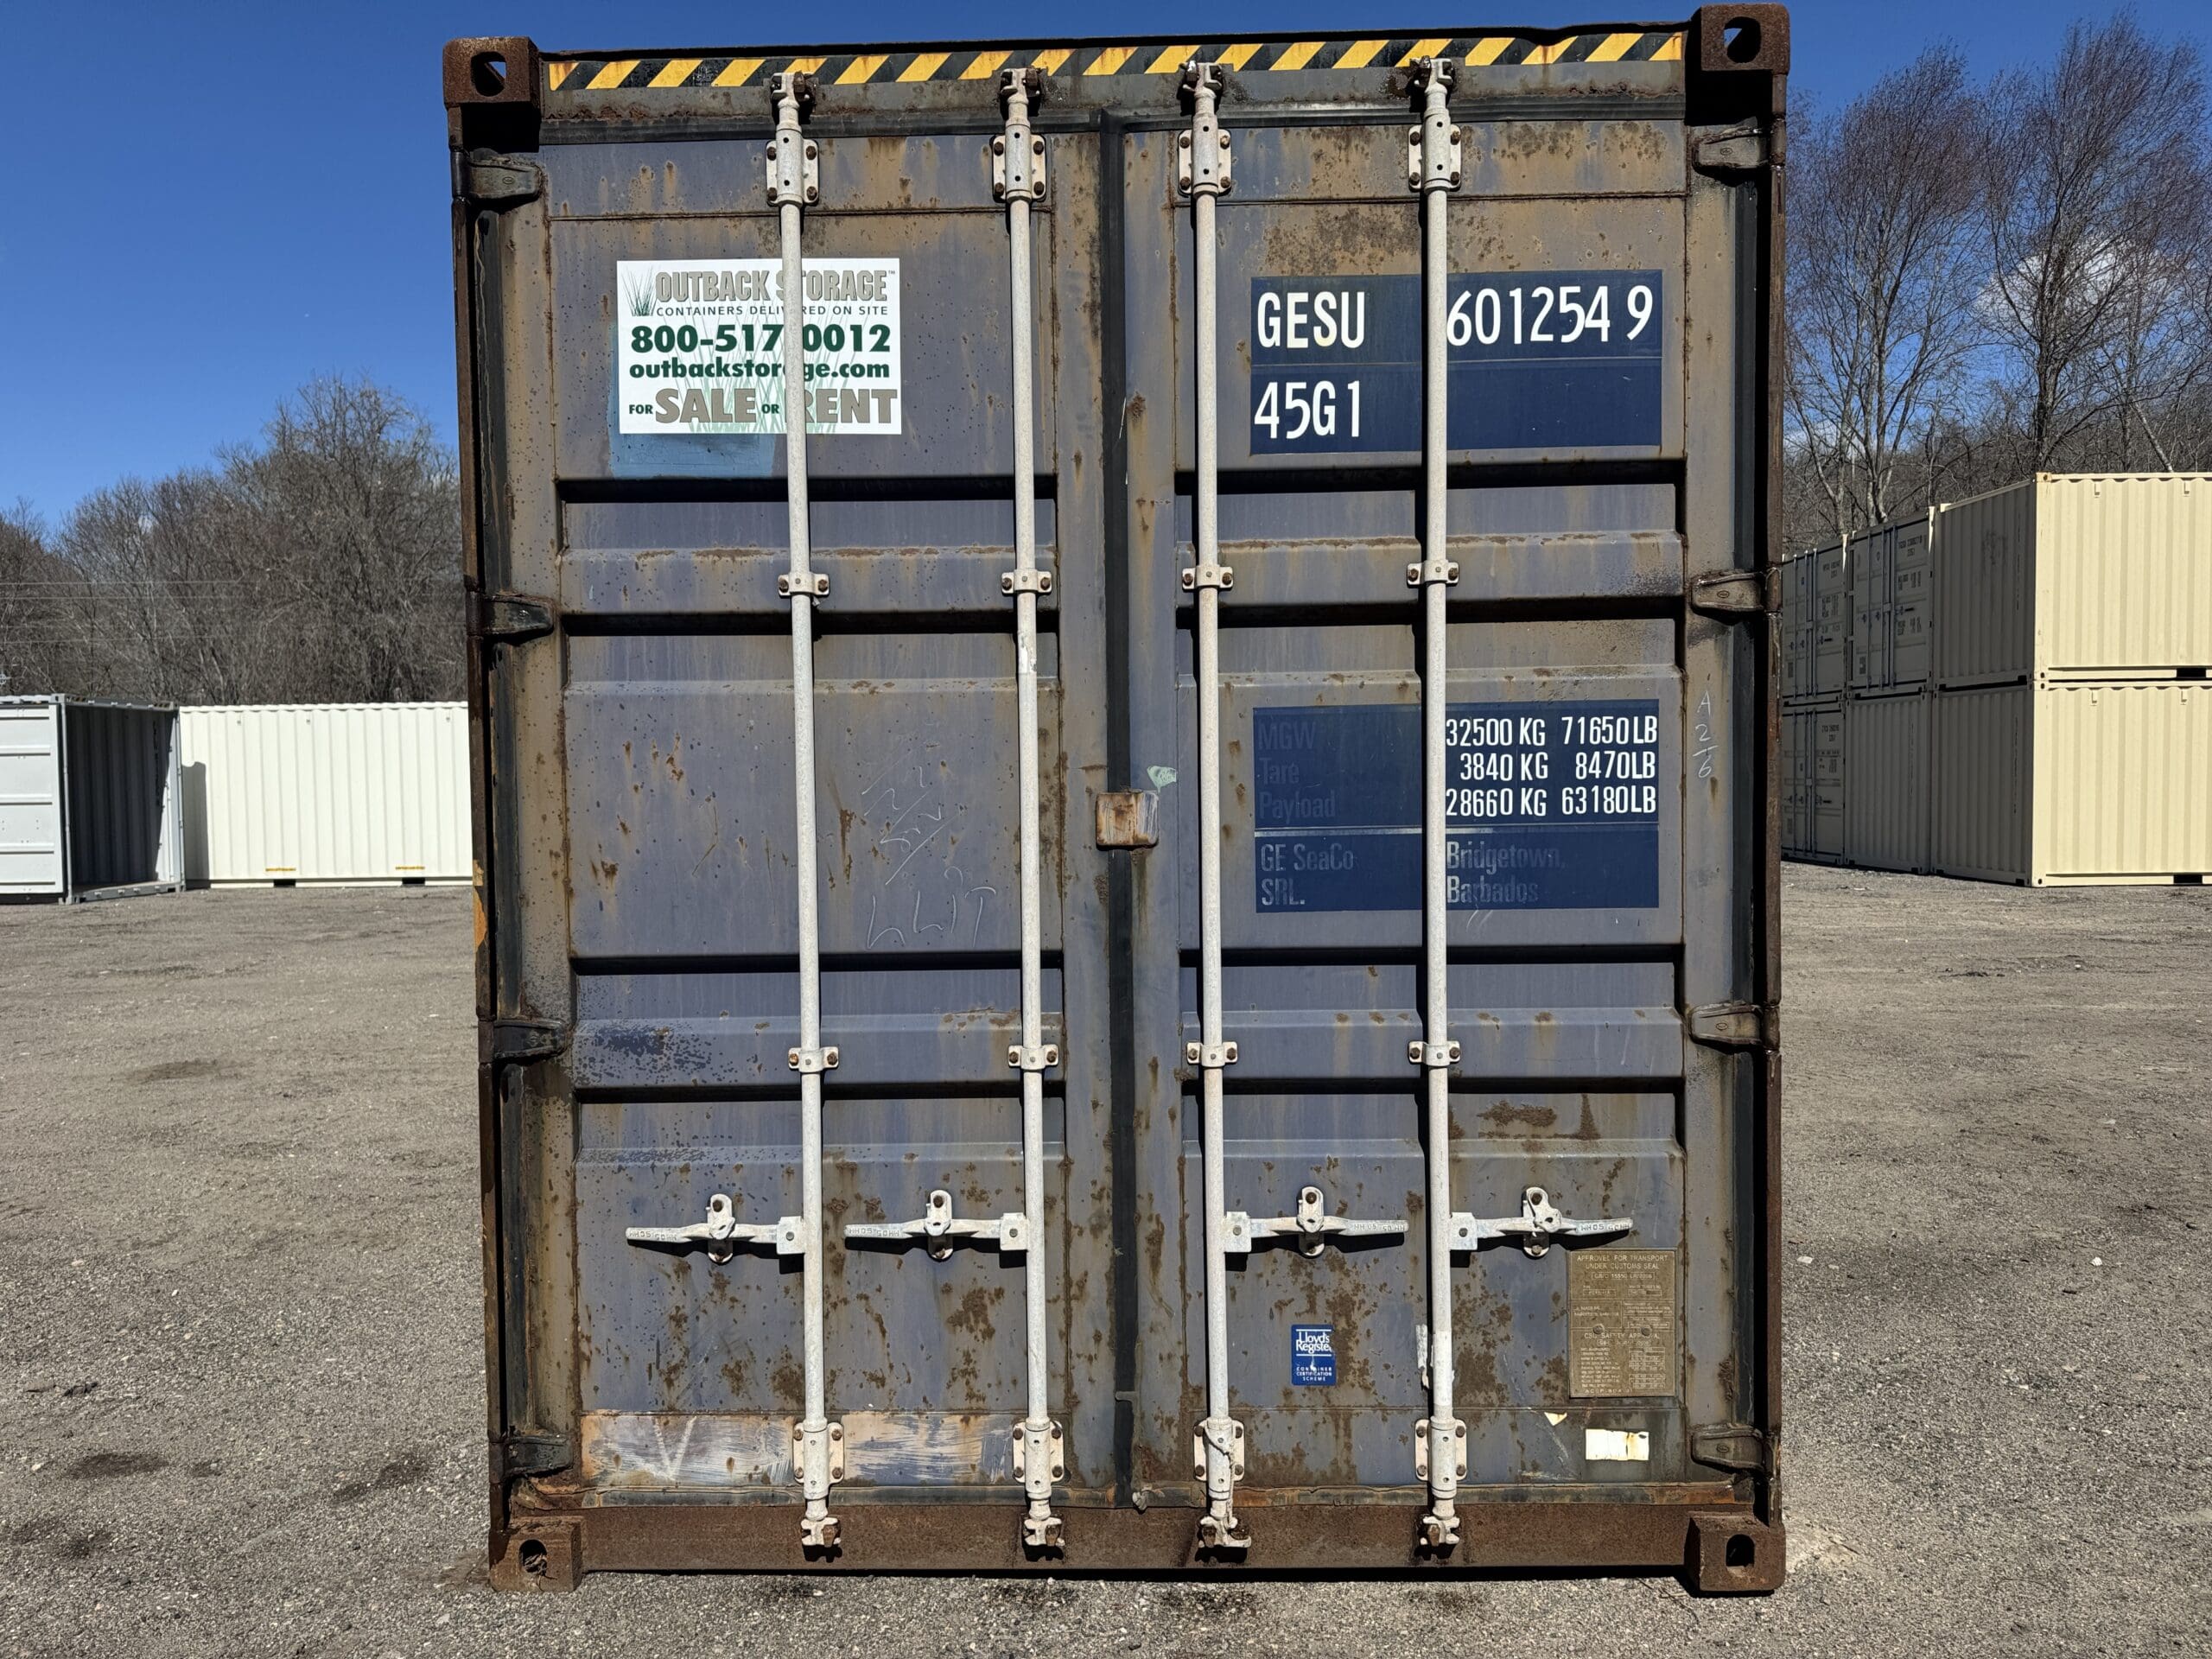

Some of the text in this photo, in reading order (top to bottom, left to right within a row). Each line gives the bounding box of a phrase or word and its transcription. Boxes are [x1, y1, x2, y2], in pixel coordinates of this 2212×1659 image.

[656, 270, 771, 302] OUTBACK
[657, 306, 743, 316] CONTAINERS
[832, 306, 852, 315] ON
[859, 306, 888, 315] SITE
[1257, 285, 1654, 349] GESU 601254 9
[632, 324, 891, 353] 800-5170012
[630, 356, 890, 382] outbackstorge.com
[629, 404, 653, 414] FOR
[655, 389, 757, 423] SALE
[761, 404, 779, 414] OR
[1254, 380, 1360, 440] 45G1
[1258, 721, 1316, 750] MGW
[1446, 718, 1513, 747] 32500
[1519, 717, 1546, 746] KG
[1259, 757, 1300, 785] Tare
[1460, 753, 1513, 781] 3840
[1520, 752, 1548, 780] KG
[1259, 789, 1336, 825] Payload
[1446, 788, 1513, 817] 28660
[1520, 787, 1547, 816] KG
[1261, 843, 1354, 871] GE SeaCo
[1446, 875, 1539, 903] Barbados
[1299, 1332, 1331, 1344] Lloyd's
